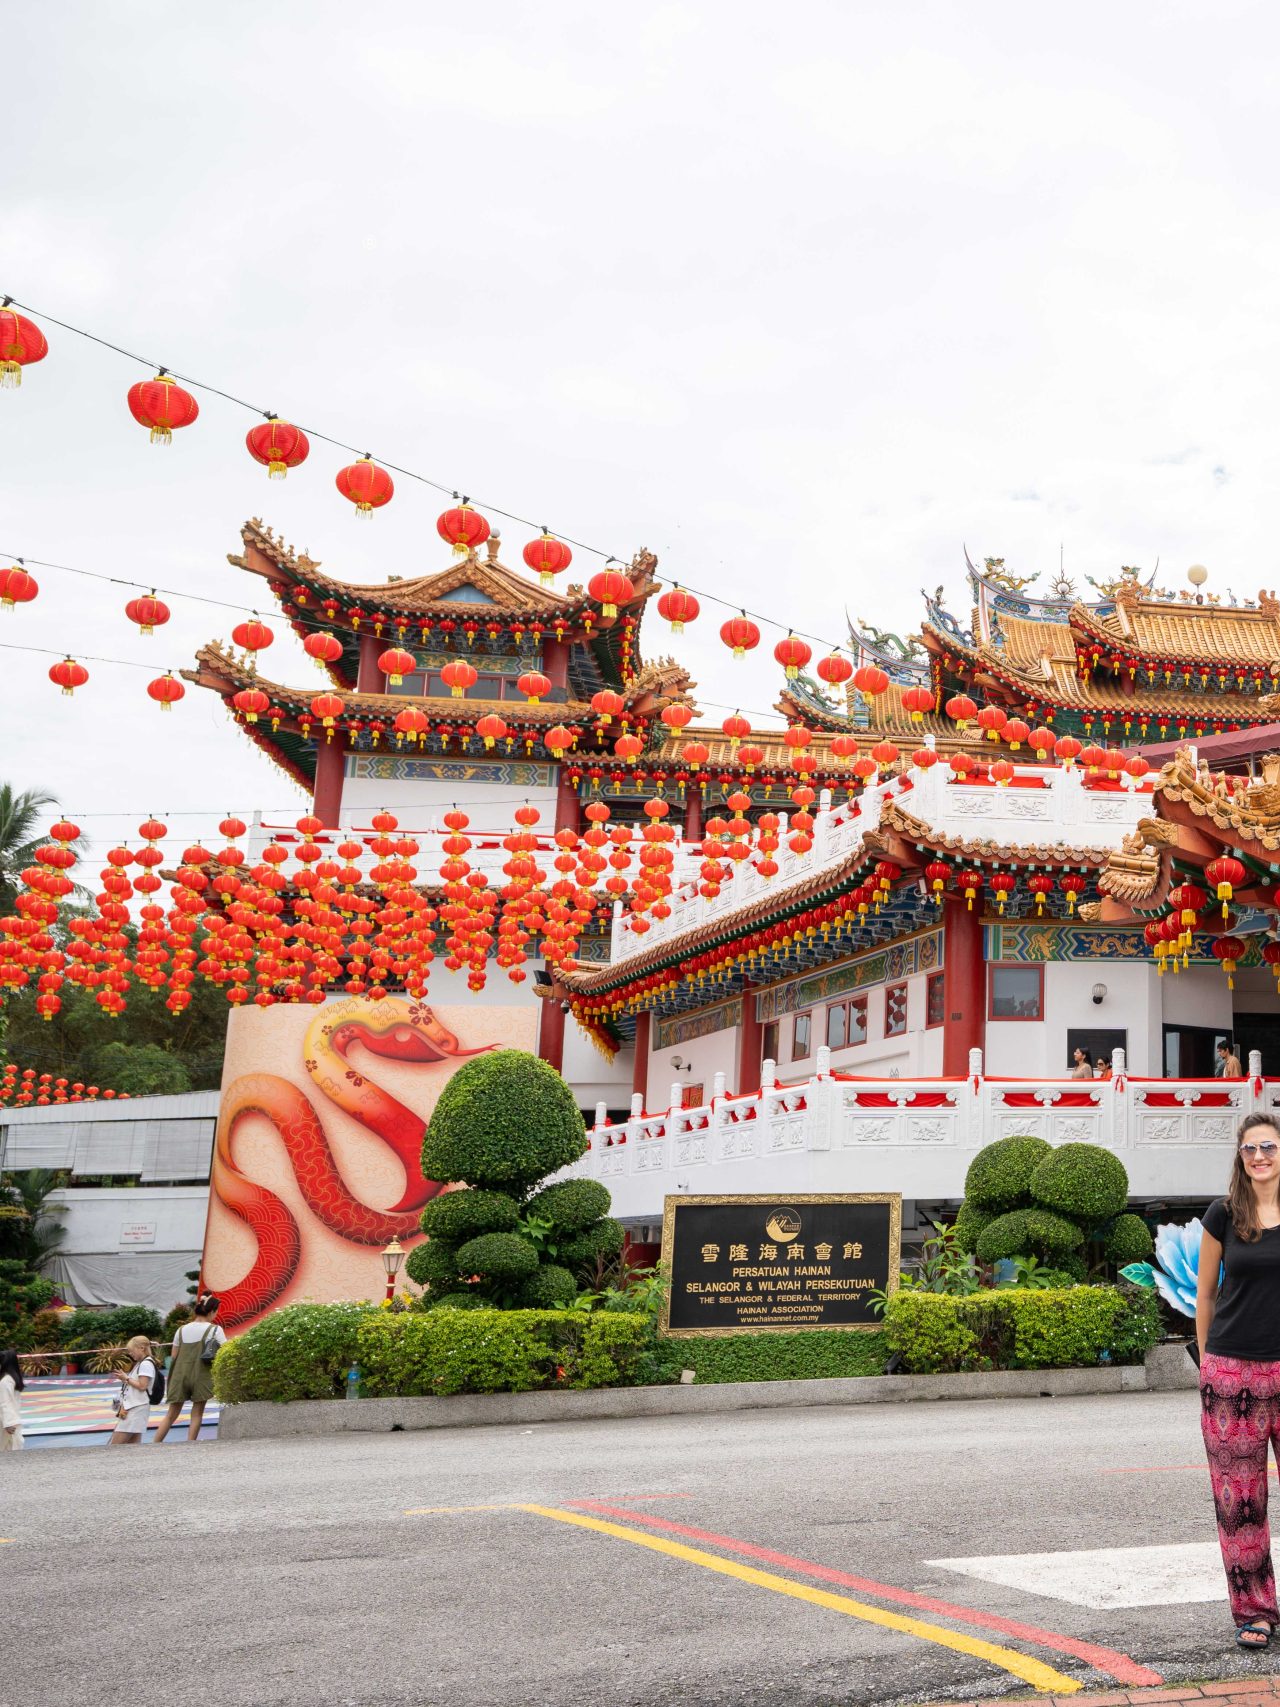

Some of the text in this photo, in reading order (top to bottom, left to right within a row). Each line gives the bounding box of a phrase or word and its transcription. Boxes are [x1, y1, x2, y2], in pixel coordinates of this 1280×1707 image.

[701, 1242, 863, 1263] 雪隆海南會館
[732, 1265, 831, 1278] PERSATUAN HAINAN
[686, 1278, 875, 1293] SELANGOR & WILAYAH PERSEKUTUAN
[699, 1296, 715, 1304] THE
[719, 1295, 763, 1304] SELANGOR
[777, 1294, 813, 1302] FEDERAL
[818, 1293, 861, 1301] TERRITORY
[737, 1305, 824, 1315] HAINAN ASSOCIATION
[740, 1314, 819, 1323] www.hainannet.com.my
